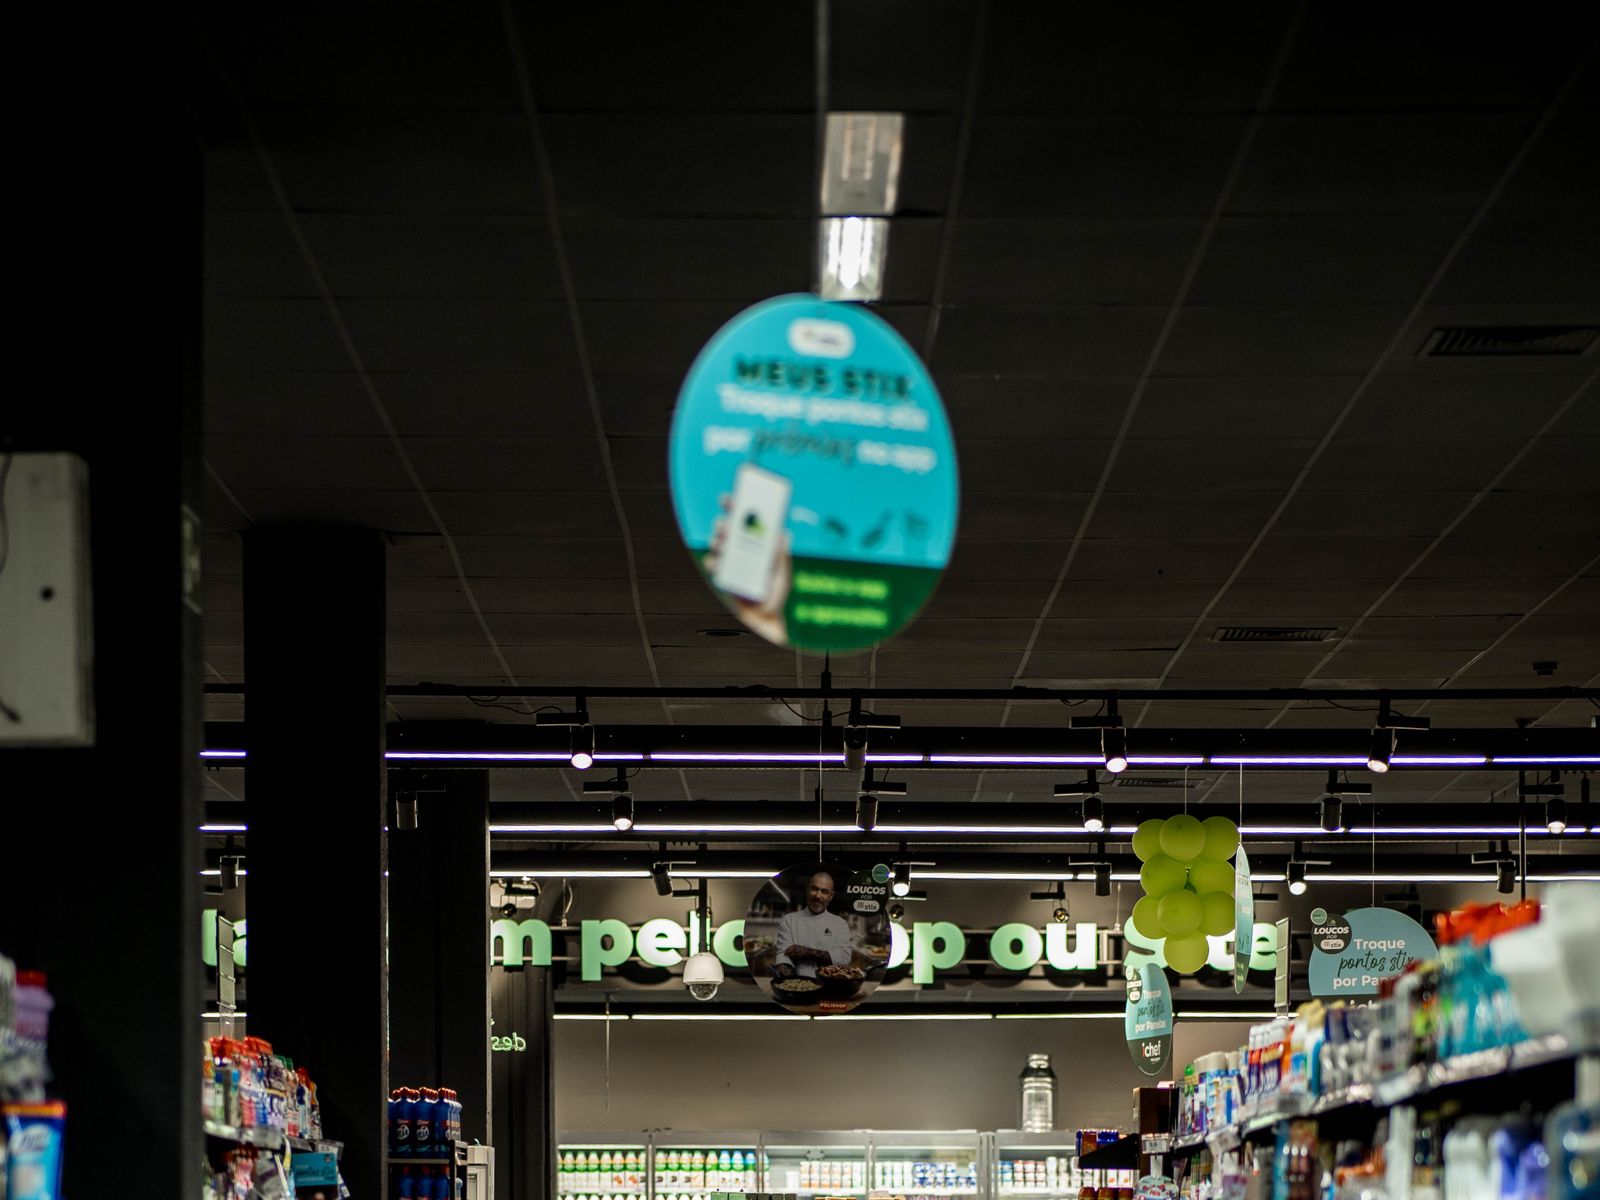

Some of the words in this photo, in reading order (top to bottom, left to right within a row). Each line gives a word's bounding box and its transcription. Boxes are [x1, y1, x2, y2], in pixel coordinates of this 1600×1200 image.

[847, 885, 886, 895] LOUCOS
[864, 903, 877, 911] stix
[1313, 926, 1350, 935] LOUCOS
[989, 921, 1098, 971] ou
[1353, 938, 1406, 952] Troque
[1337, 950, 1385, 978] pontos
[1332, 975, 1358, 990] por
[1135, 1024, 1145, 1034] por
[1142, 1040, 1160, 1057] ichef
